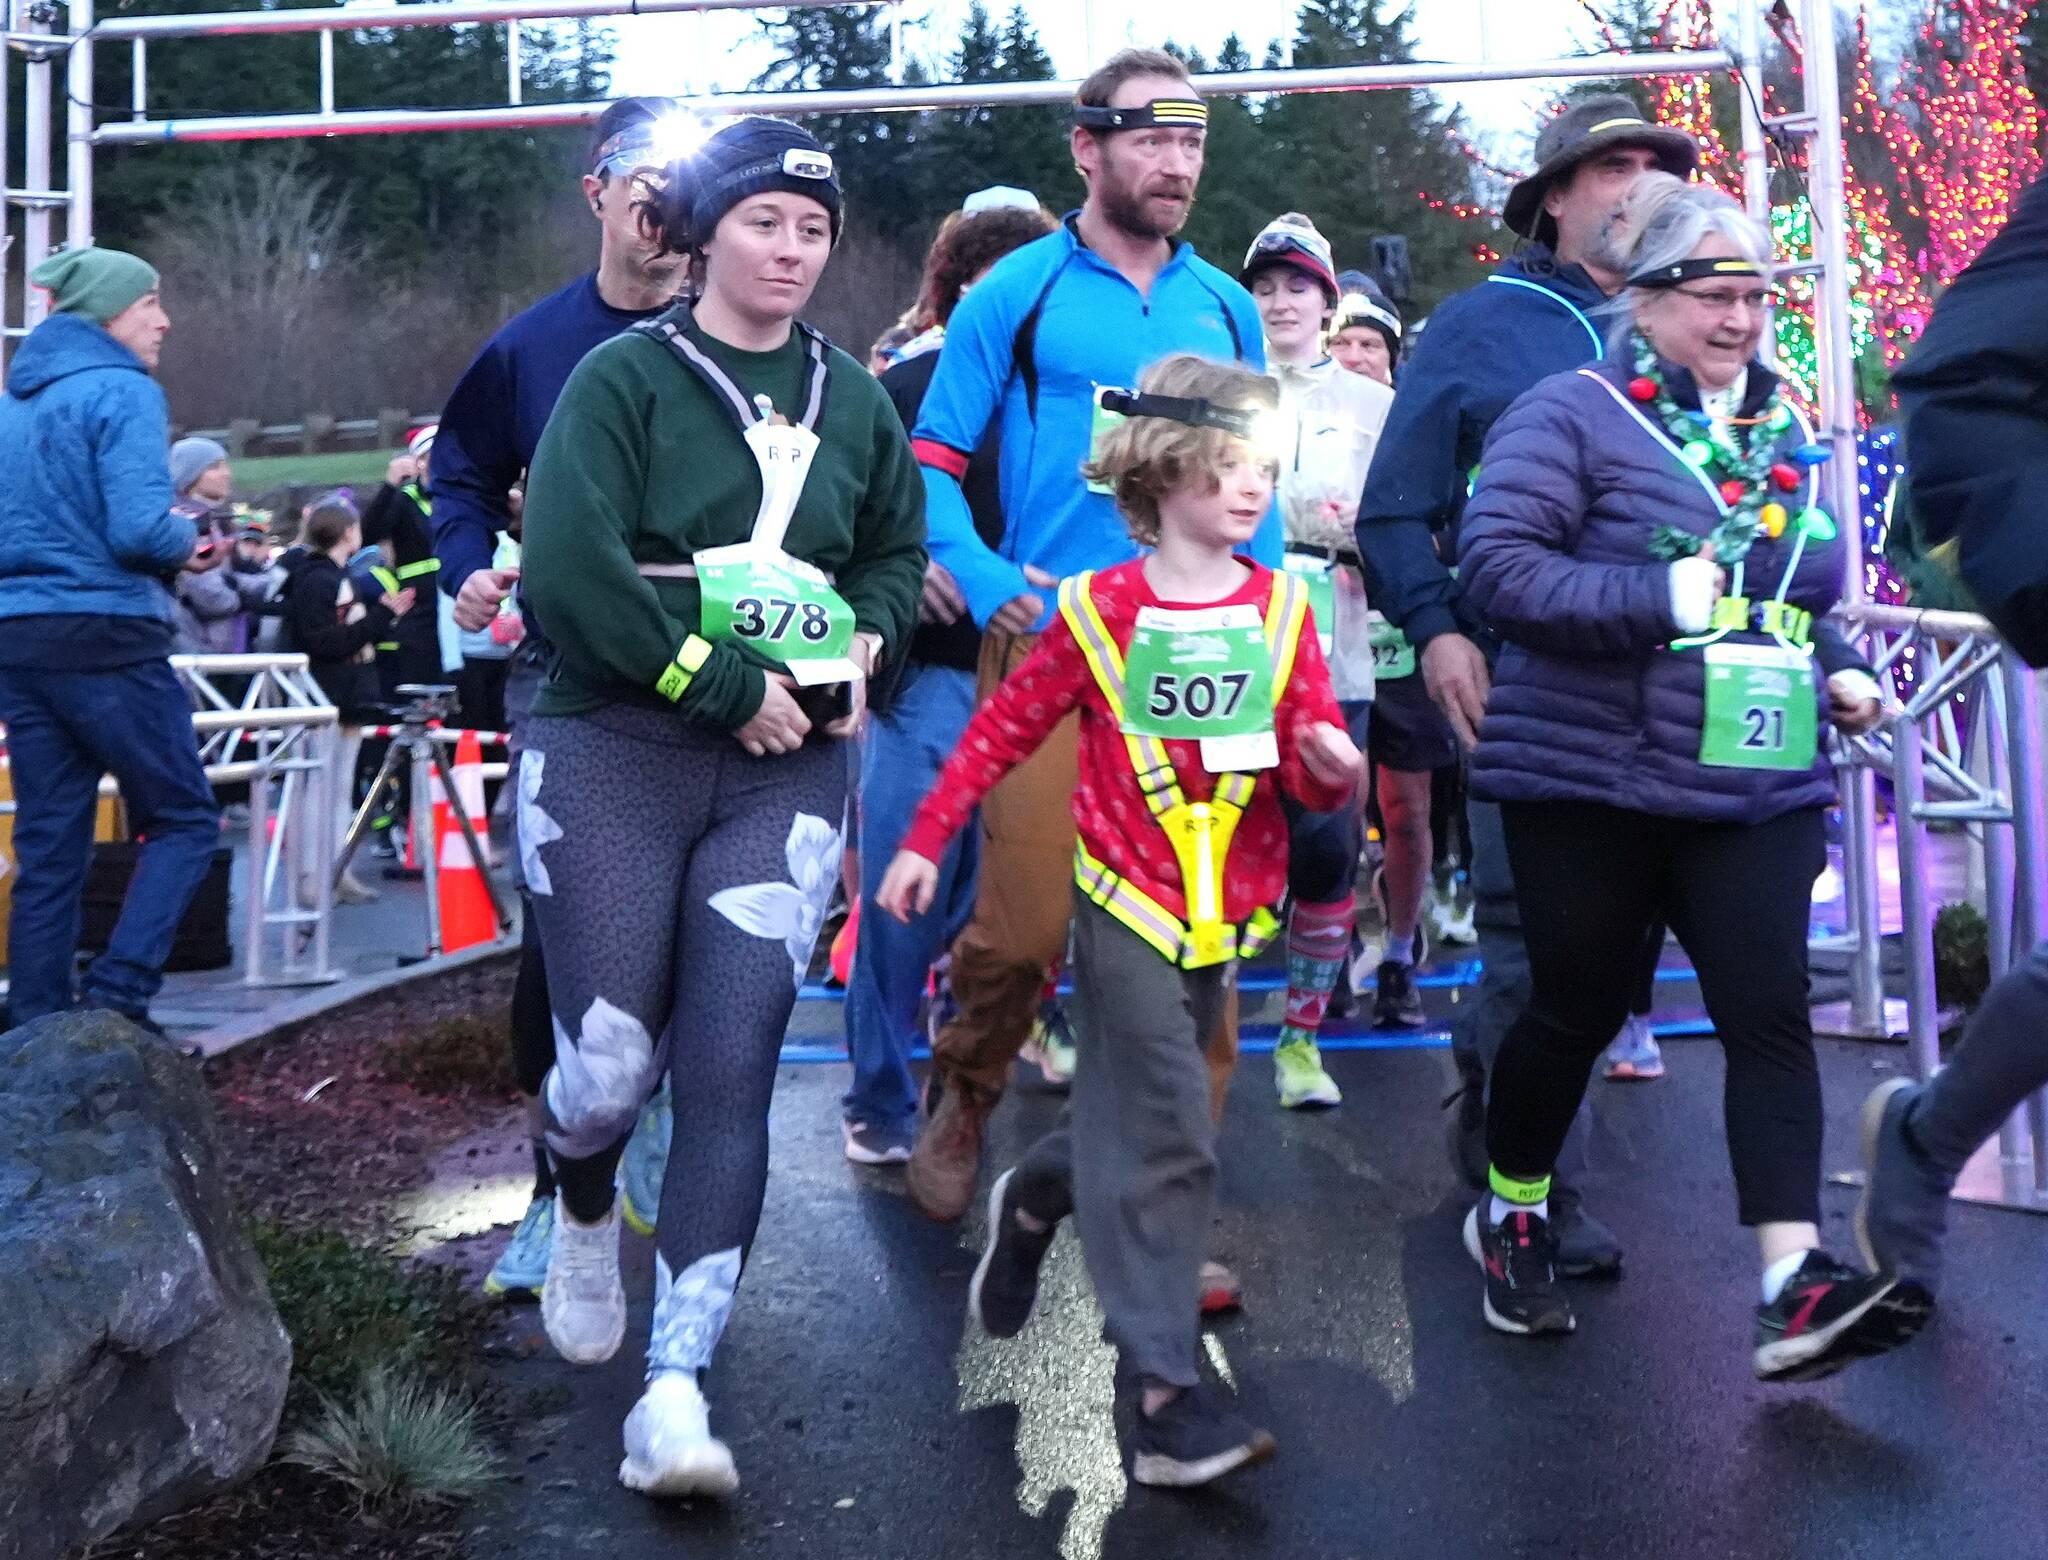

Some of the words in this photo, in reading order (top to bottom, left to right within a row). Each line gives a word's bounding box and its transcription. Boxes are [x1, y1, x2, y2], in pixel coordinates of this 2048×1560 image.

[732, 598, 830, 641] 378
[1149, 673, 1250, 718] 507
[1743, 707, 1786, 748] 21
